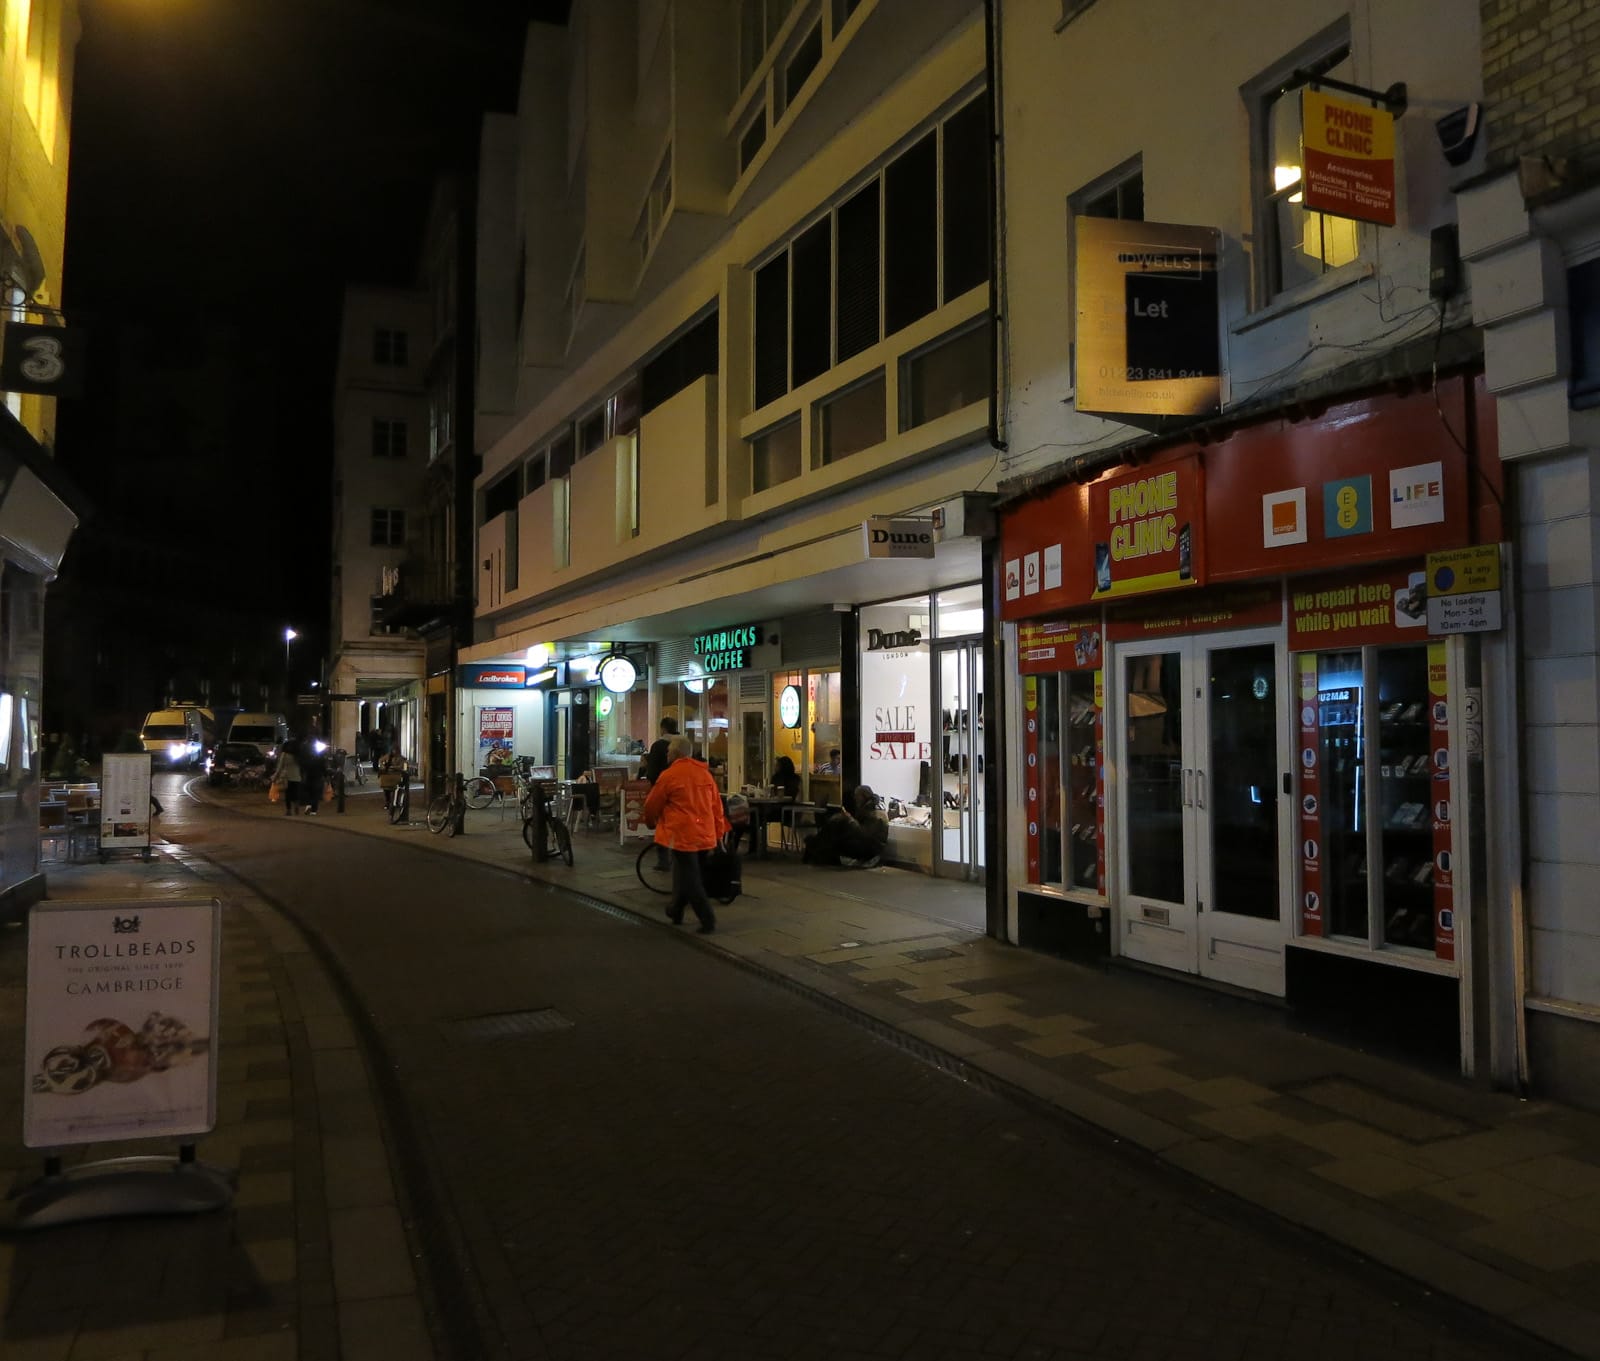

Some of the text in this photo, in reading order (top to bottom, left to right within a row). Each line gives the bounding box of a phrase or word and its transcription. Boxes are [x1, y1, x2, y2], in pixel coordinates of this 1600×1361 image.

[1325, 104, 1373, 134] PHONE
[1326, 127, 1373, 155] CLINIC
[1327, 162, 1373, 180] Accessories
[1309, 170, 1391, 199] Unlocking Repairing
[1311, 183, 1390, 209] Batteries Chargers
[1133, 297, 1169, 318] Let
[20, 336, 65, 384] 3
[1109, 471, 1177, 524] PHONE
[1393, 481, 1441, 503] LIFE
[872, 529, 931, 544] Dune
[1111, 513, 1177, 562] CLINIC
[1293, 592, 1314, 612] We
[1315, 585, 1357, 609] repair
[1358, 584, 1392, 604] here
[1441, 597, 1486, 607] No loading
[1296, 604, 1391, 633] while you wait
[1444, 610, 1461, 618] Mon
[1468, 607, 1483, 616] Sat
[1440, 621, 1461, 630] 10am
[1468, 620, 1488, 628] 4pm
[694, 626, 757, 655] STARBUCKS
[867, 629, 921, 650] Dune
[704, 650, 743, 672] COFFEE
[479, 674, 518, 683] Ladbrokes
[482, 713, 512, 722] BEST ODDS
[482, 721, 512, 729] GUARANTEED
[875, 705, 916, 731] SALE
[870, 742, 932, 760] SALE
[56, 940, 196, 959] TROLLBEADS
[66, 977, 184, 995] CAMBRIDGE
